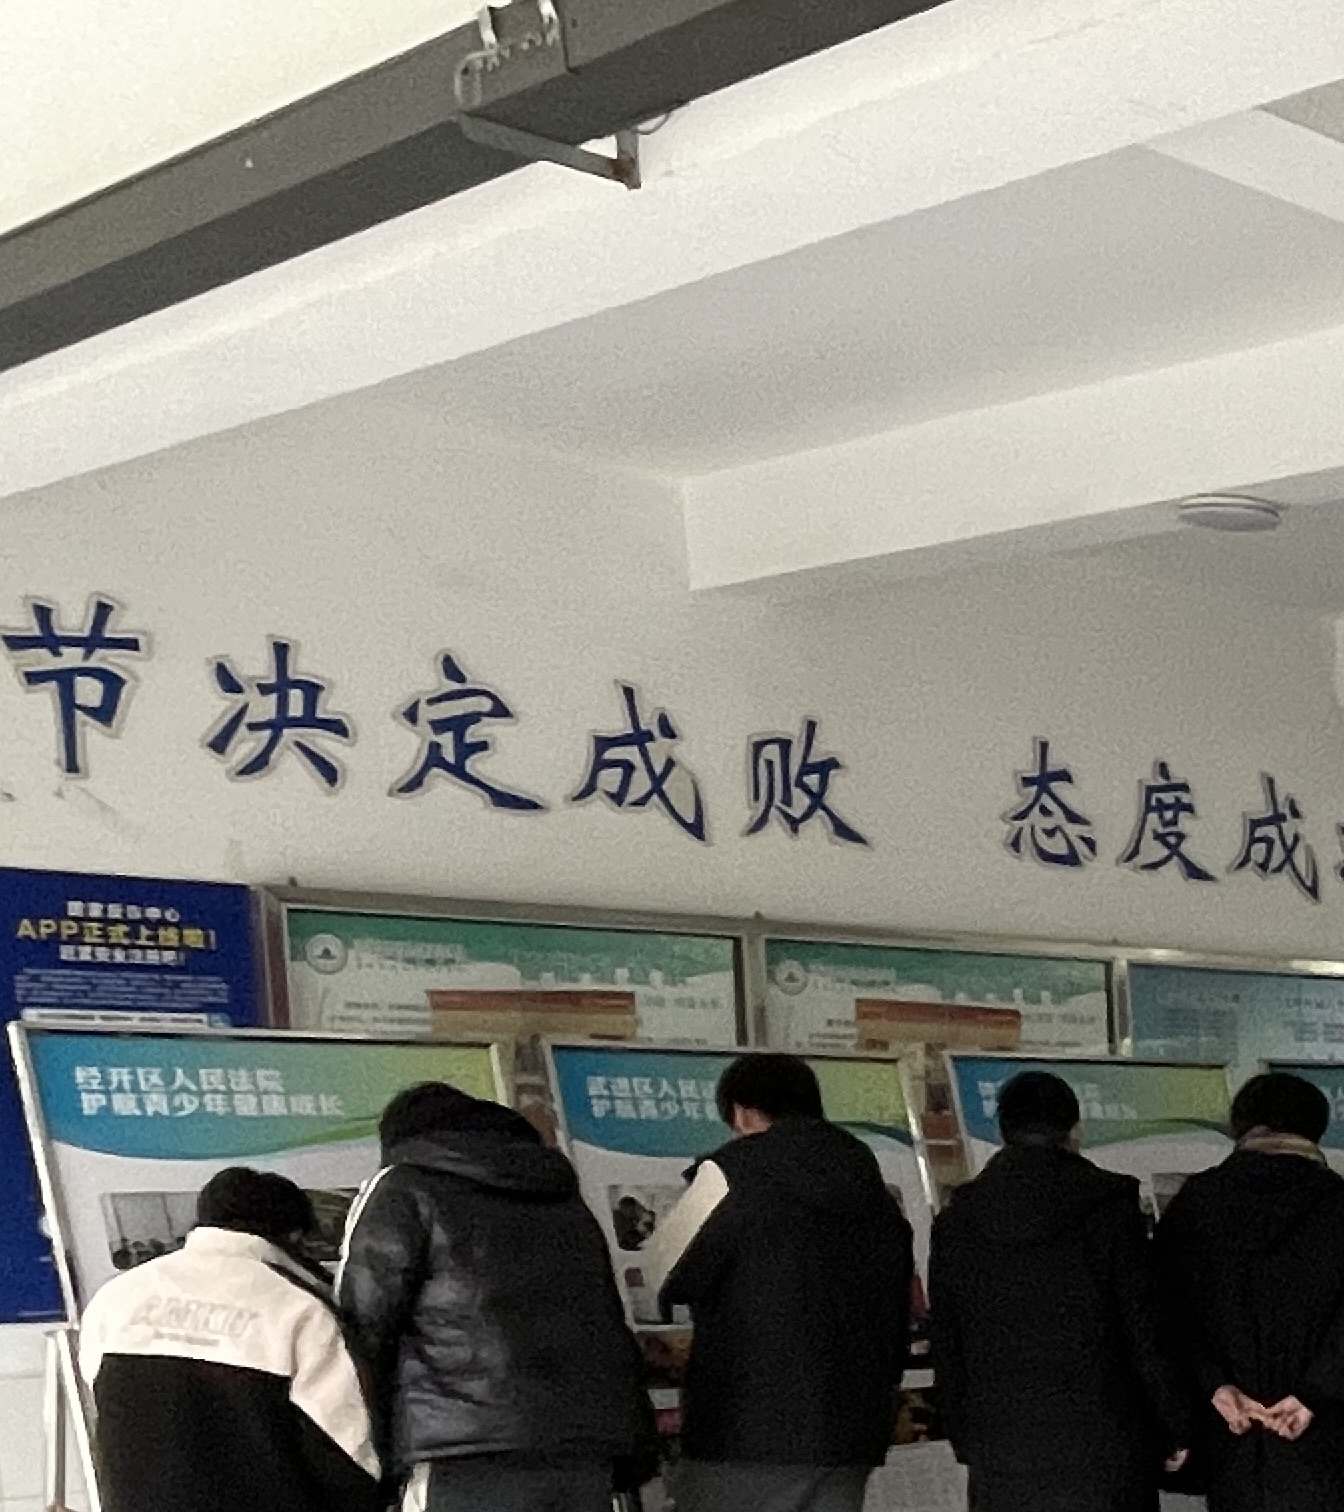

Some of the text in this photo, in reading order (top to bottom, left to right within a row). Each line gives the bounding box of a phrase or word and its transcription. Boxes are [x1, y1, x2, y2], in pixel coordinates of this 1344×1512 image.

[2, 600, 871, 846] 节决定成败
